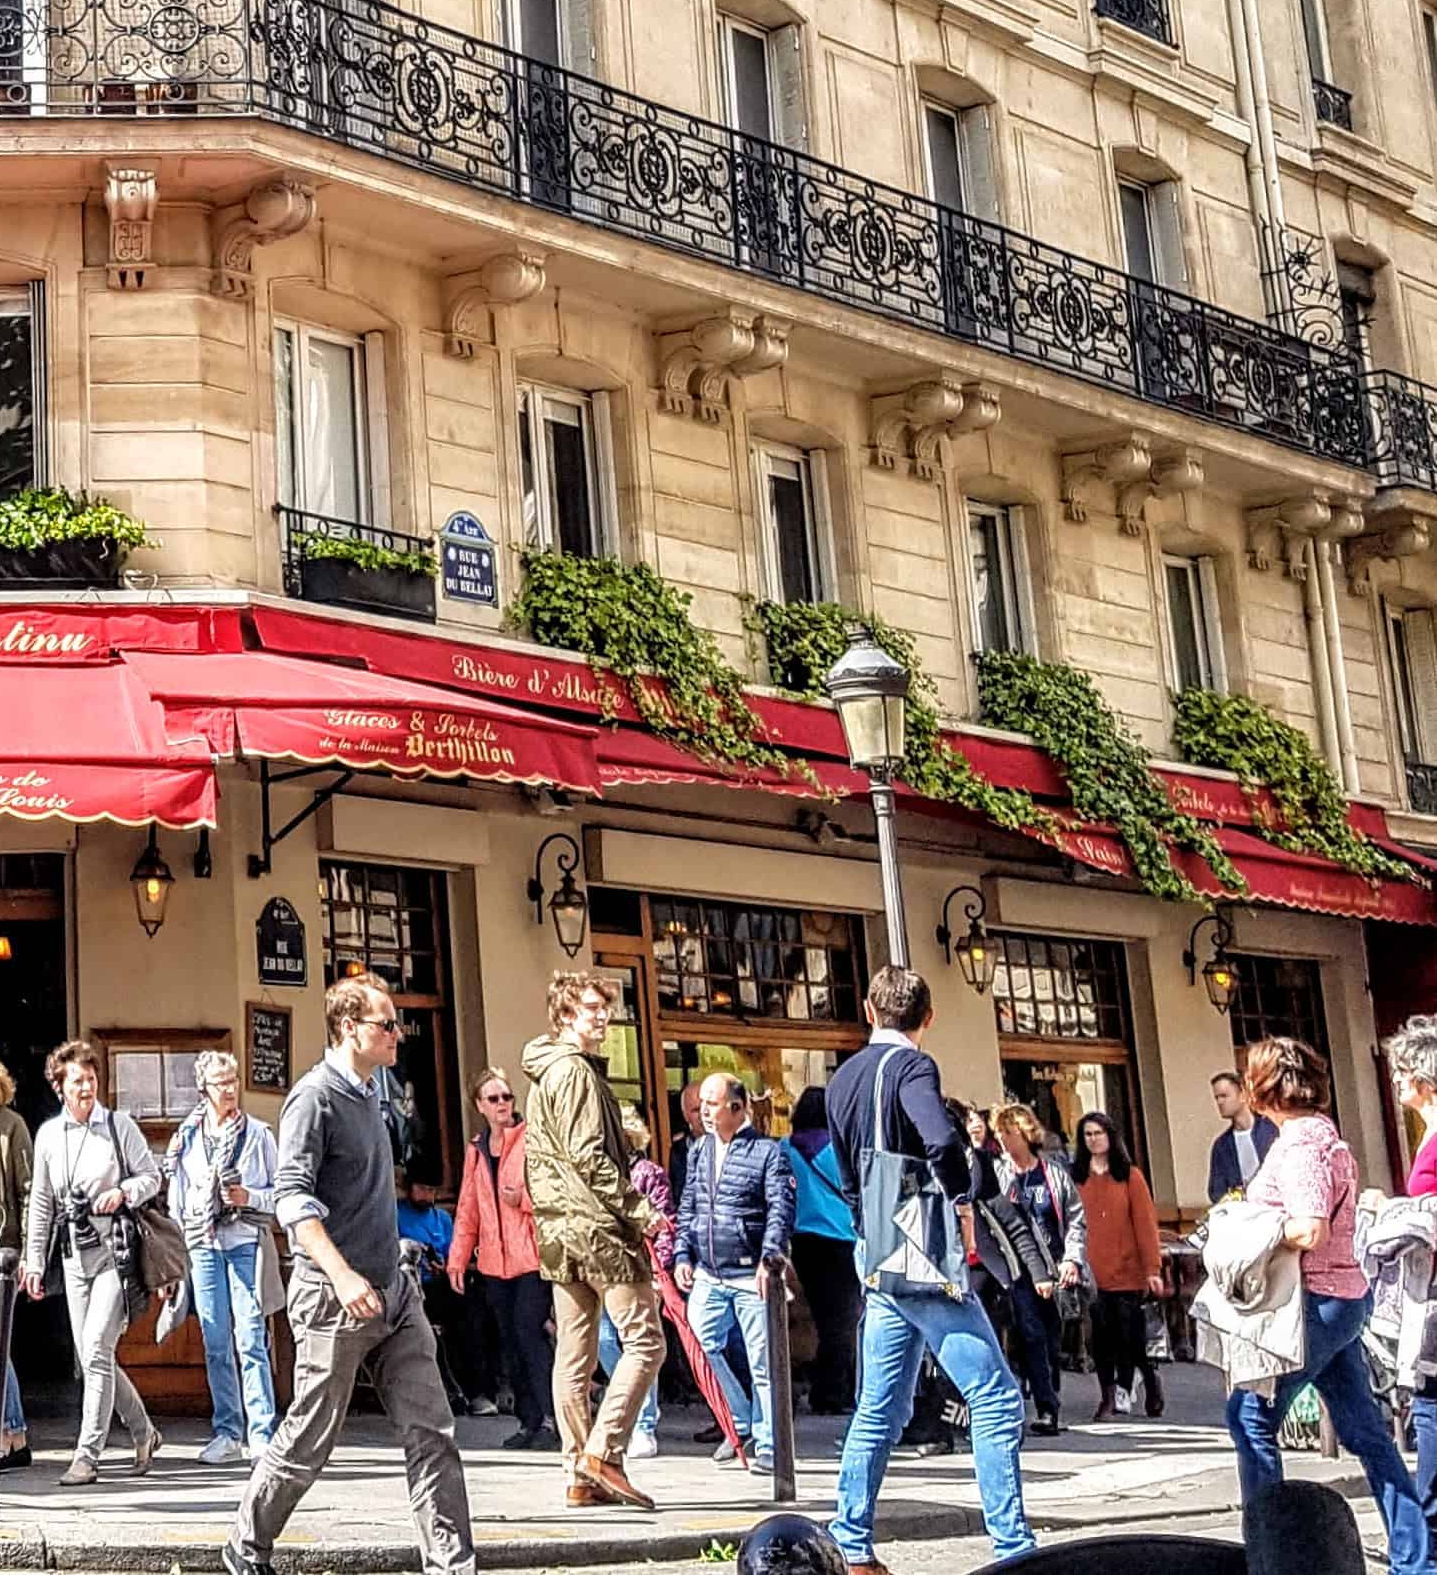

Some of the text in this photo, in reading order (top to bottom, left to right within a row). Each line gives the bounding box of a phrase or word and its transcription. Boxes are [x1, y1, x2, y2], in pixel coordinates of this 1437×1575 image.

[459, 550, 479, 564] RUE
[458, 565, 481, 579] JEAN
[446, 577, 492, 597] DU BELLAY
[452, 655, 521, 689] Bière
[324, 709, 499, 742] Glaces & Sorbets
[406, 733, 515, 766] Berthillon
[10, 771, 50, 787] de
